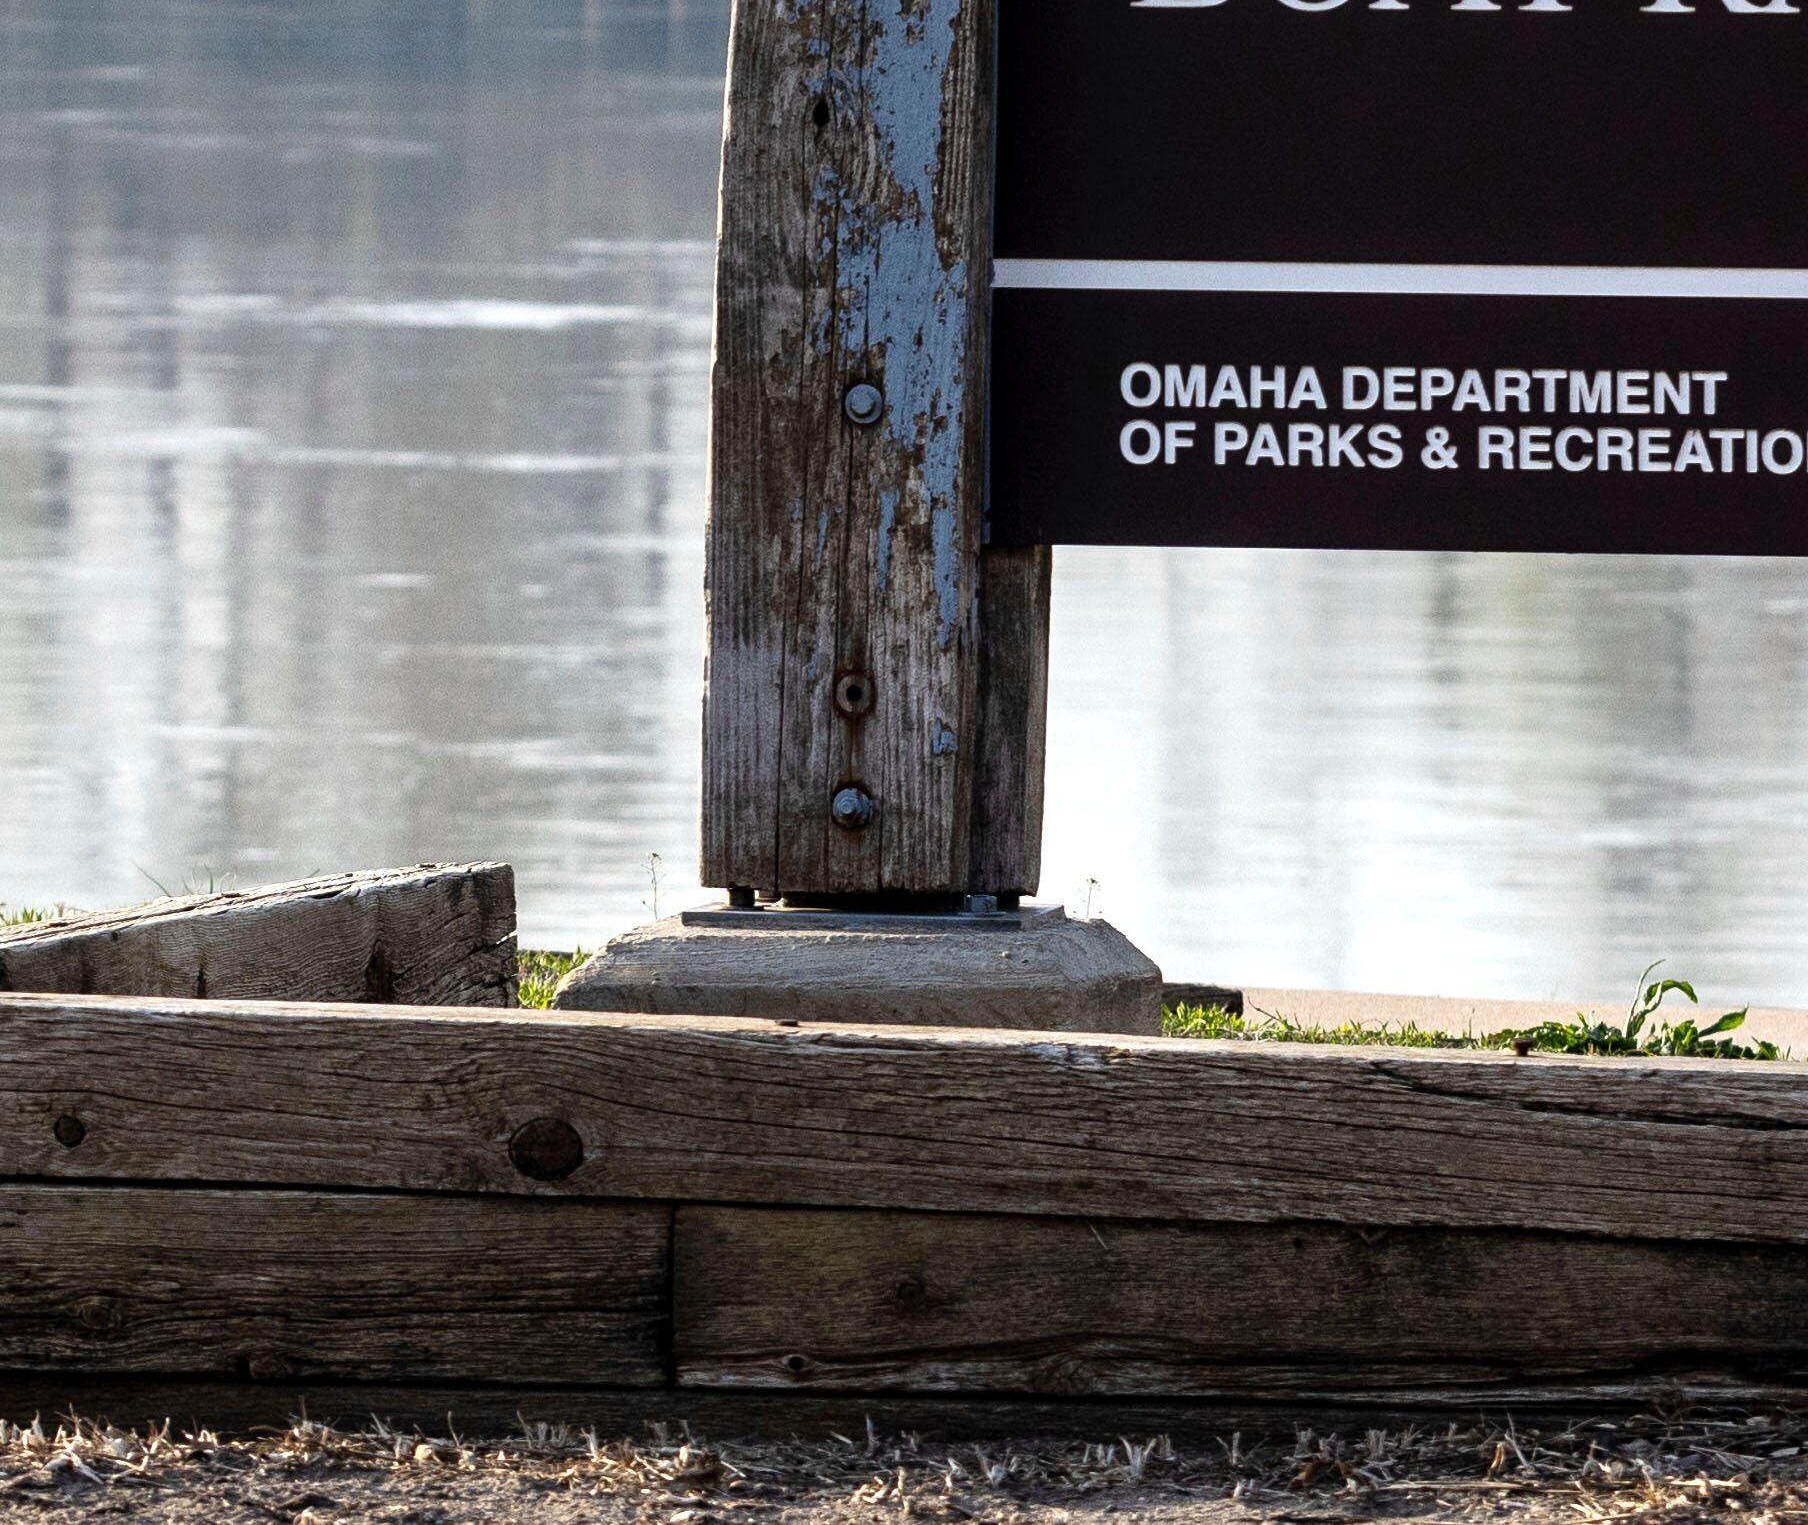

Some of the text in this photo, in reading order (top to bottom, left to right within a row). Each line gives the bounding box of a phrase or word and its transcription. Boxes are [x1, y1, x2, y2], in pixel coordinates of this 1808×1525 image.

[1120, 362, 1728, 415] OMAHA DEPARTMENT
[1119, 420, 1196, 465] OF
[1214, 422, 1403, 469] PARKS
[1420, 426, 1459, 470] &
